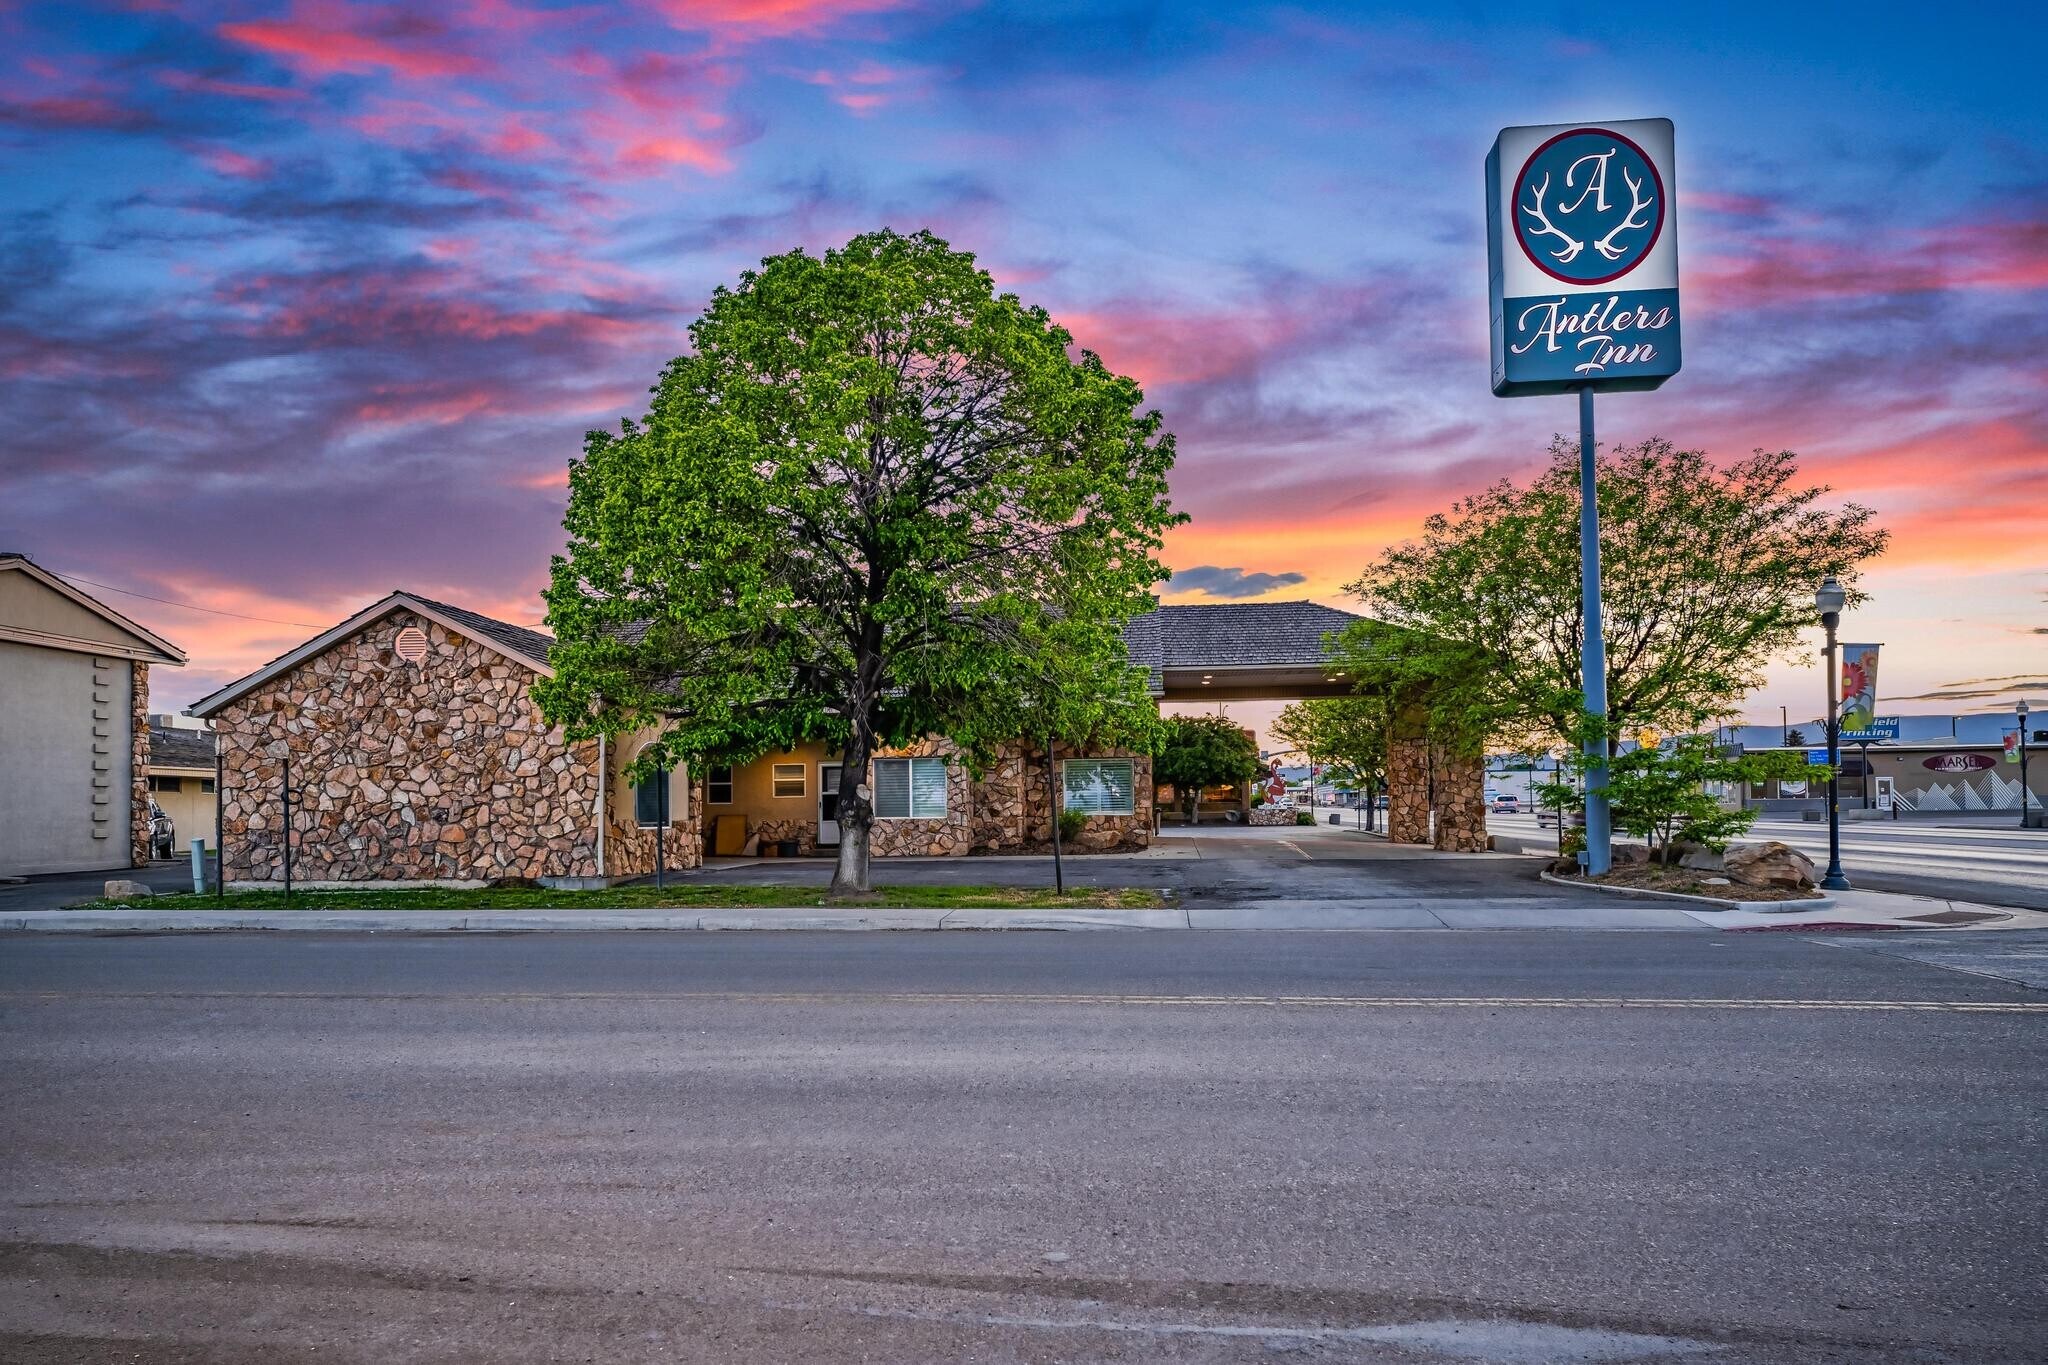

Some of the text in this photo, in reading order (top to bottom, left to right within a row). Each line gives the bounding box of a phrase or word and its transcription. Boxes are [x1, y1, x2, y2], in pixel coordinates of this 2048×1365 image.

[1558, 148, 1616, 214] A
[1510, 295, 1674, 355] Antlers
[1574, 335, 1658, 375] Inn
[1873, 717, 1898, 726] ield
